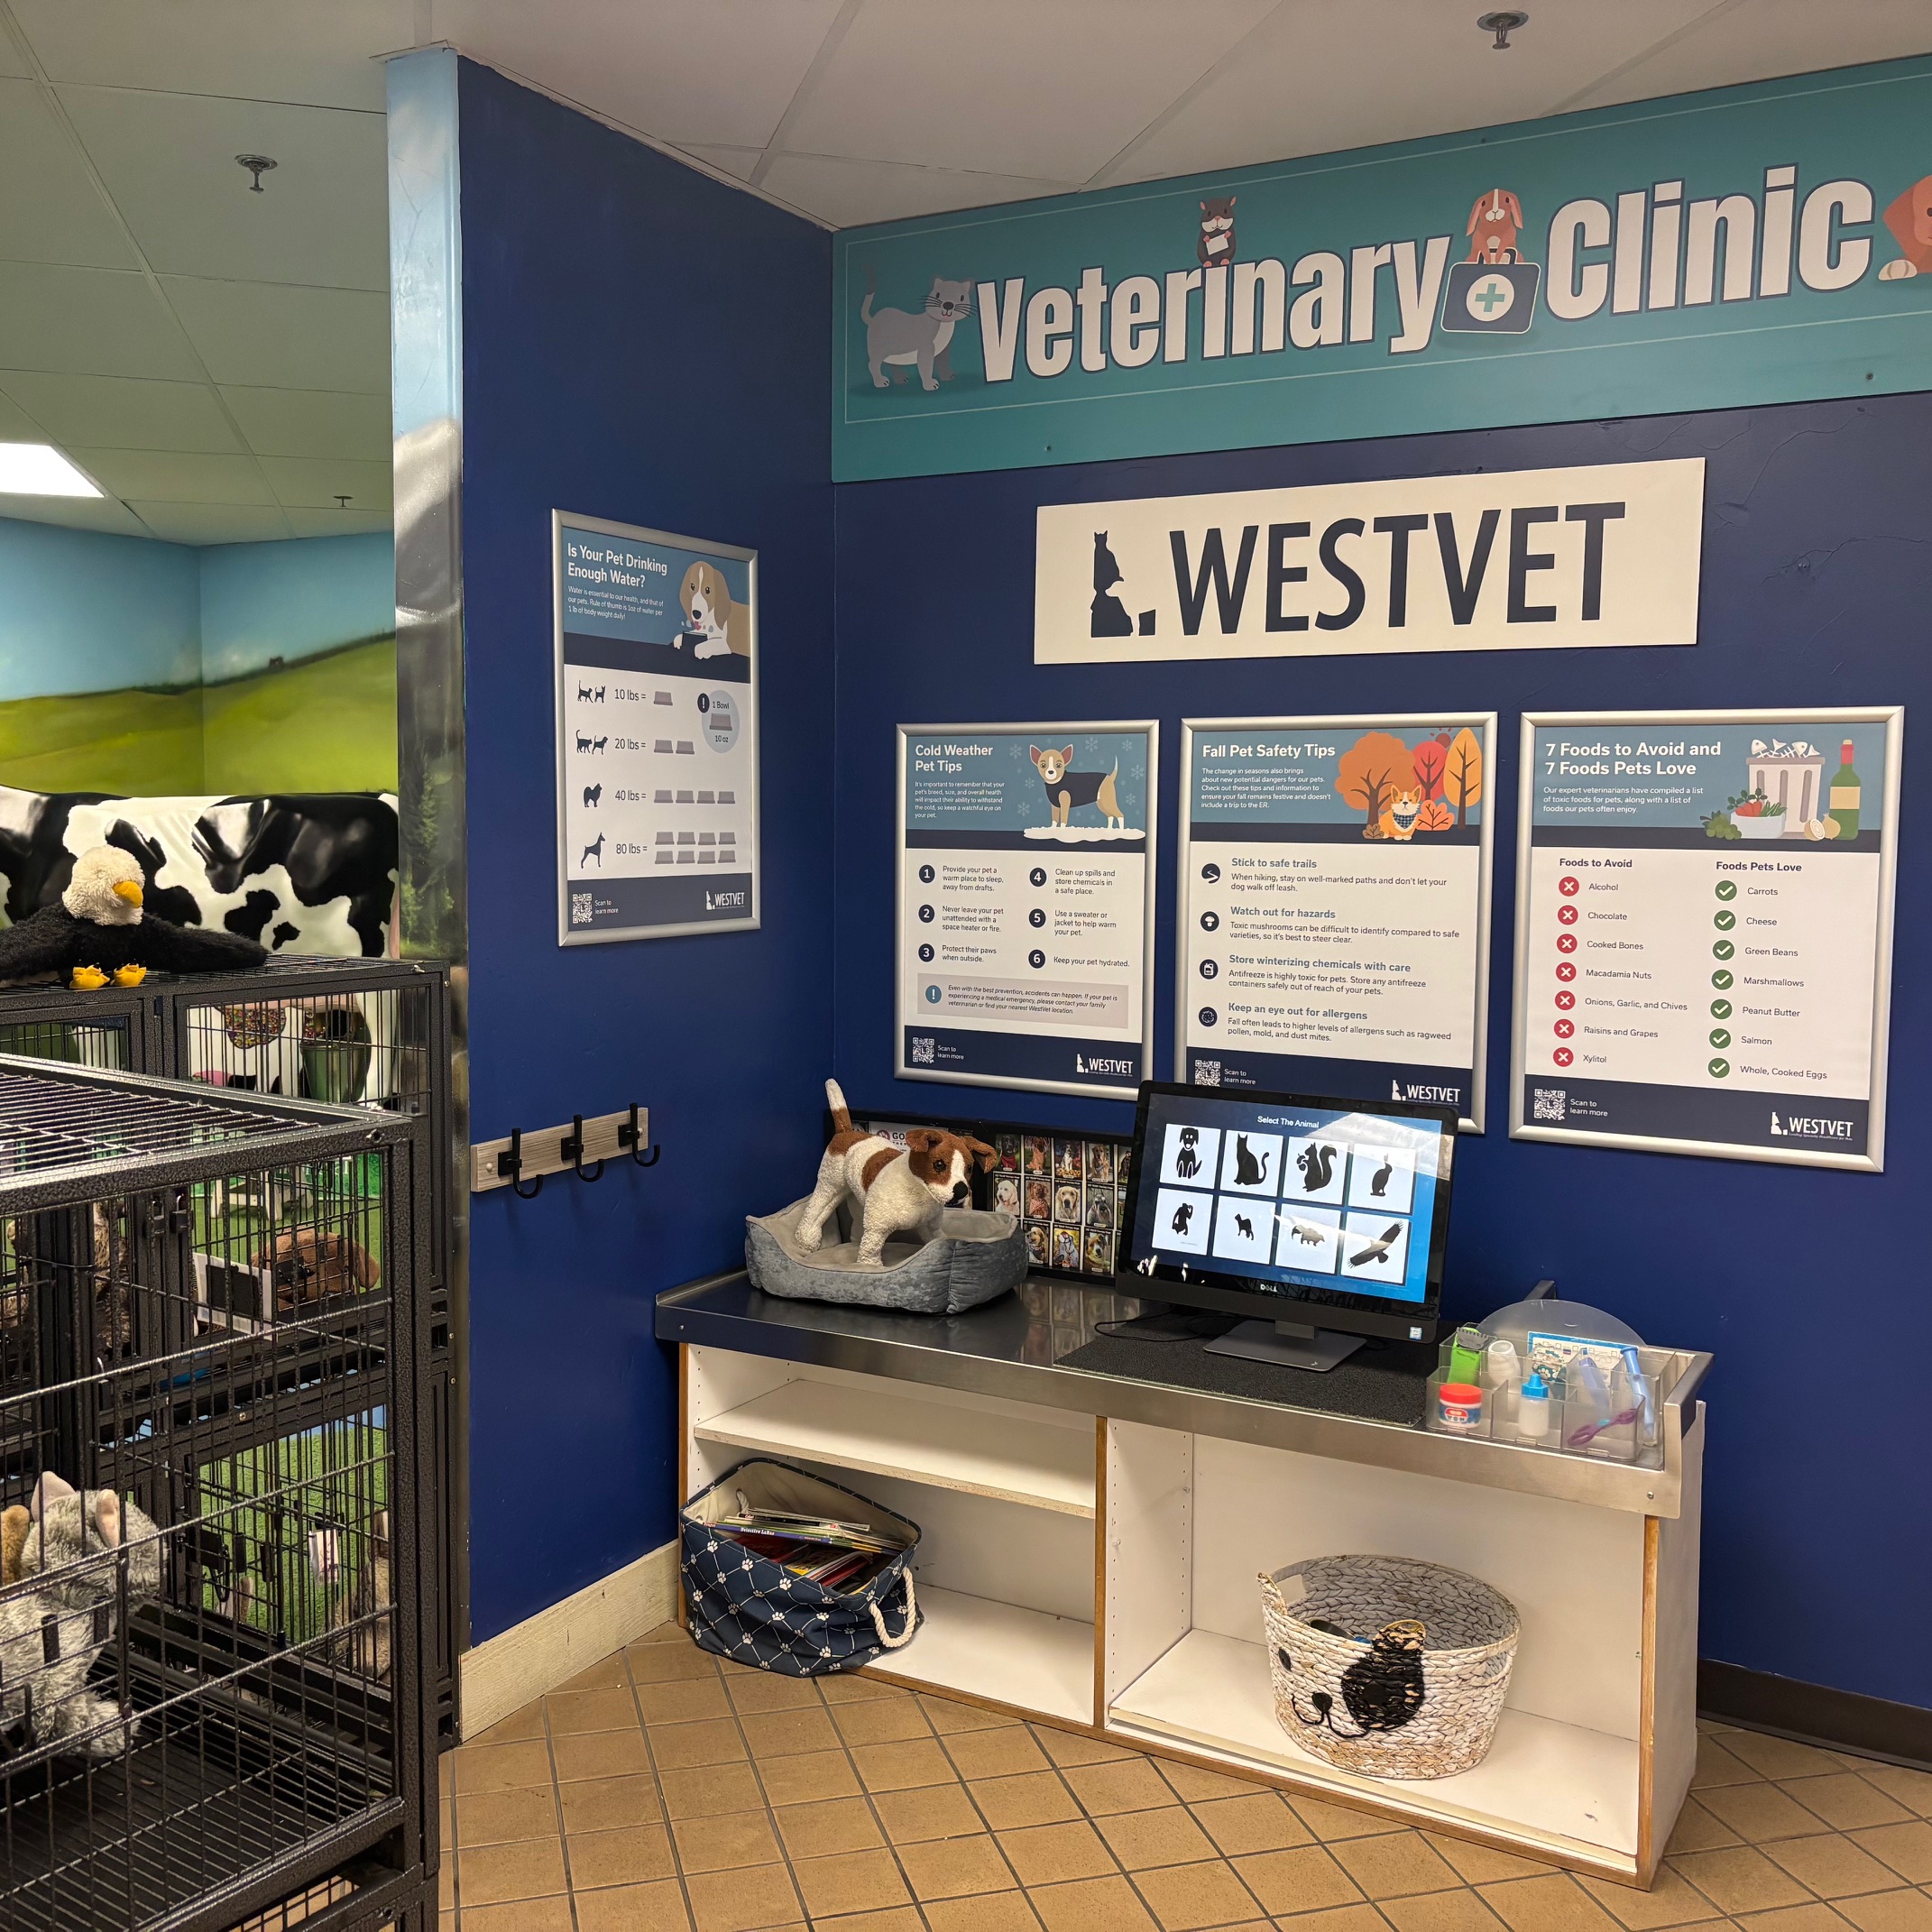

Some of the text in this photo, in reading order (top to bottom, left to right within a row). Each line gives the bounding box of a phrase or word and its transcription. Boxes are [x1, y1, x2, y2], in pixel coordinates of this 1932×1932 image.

[977, 164, 1876, 384] Veterinary Clinic
[567, 543, 667, 575] Is Your Pet Drinking
[567, 562, 646, 587] Enough Water?
[1169, 501, 1627, 639] WESTVET
[615, 689, 625, 700] 10
[626, 691, 639, 701] lbs
[614, 738, 625, 749] 20
[626, 739, 639, 750] lbs
[1545, 741, 1722, 757] 7 Foods to Avoid and
[915, 744, 993, 756] Cold Weather
[1202, 743, 1336, 759] Fall Pet Safety Tips
[915, 760, 962, 773] Pet Tips
[1545, 761, 1697, 776] 7 Foods Pets Love
[615, 789, 626, 801] 40
[626, 790, 639, 800] lbs
[616, 843, 627, 854] 80
[629, 844, 640, 854] lbs
[1231, 858, 1317, 869] Stick to safe trails
[1559, 858, 1633, 869] Foods to Avoid
[1716, 861, 1802, 872] Foods Pets Love
[924, 869, 931, 879] 1
[967, 867, 980, 875] your
[981, 867, 992, 875] pet
[1055, 869, 1073, 877] Clean
[1084, 869, 1101, 878] spills
[1101, 869, 1116, 878] and
[961, 875, 977, 884] place
[986, 876, 1004, 884] sleep,
[1034, 872, 1041, 882] 4
[1231, 873, 1253, 881] When
[1254, 874, 1278, 883] hiking,
[1280, 875, 1295, 883] stay
[1307, 875, 1354, 885] well-marked
[1355, 877, 1377, 886] paths
[1378, 877, 1394, 885] and
[1394, 878, 1416, 886] don't
[1417, 878, 1428, 886] let
[1429, 879, 1447, 888] your
[943, 884, 958, 892] away
[974, 884, 995, 892] drafts.
[1072, 879, 1105, 887] chemicals
[1230, 883, 1245, 892] dog
[1247, 883, 1264, 891] walk
[1265, 884, 1275, 892] off
[1588, 883, 1619, 891] Alcohol
[1061, 887, 1073, 895] safe
[1075, 888, 1094, 896] place.
[1747, 887, 1779, 897] Carrots
[714, 891, 745, 906] WESTVET
[923, 908, 930, 919] 2
[1230, 906, 1336, 918] Watch out for hazards
[1587, 912, 1627, 921] Chocolate
[1034, 913, 1041, 923] 5
[1745, 917, 1777, 927] Cheese
[1587, 941, 1644, 951] Cooked Bones
[923, 948, 930, 958] 3
[1744, 947, 1799, 958] Green Beans
[1033, 953, 1041, 964] 6
[1053, 956, 1130, 968] Keep your pet hydrated.
[1228, 954, 1411, 972] Store winterizing chemicals with care
[1586, 970, 1652, 980] Macadamia Nuts
[1743, 977, 1805, 989] Marshmallows
[1585, 998, 1688, 1011] Onions, Garlic, and Chives
[1228, 1003, 1367, 1020] Keep an eye out for allergens
[1742, 1007, 1801, 1017] Peanut Butter
[1584, 1026, 1659, 1039] Raisins and Grapes
[1741, 1036, 1772, 1045] Salmon
[1583, 1054, 1607, 1064] Xylitol
[1089, 1058, 1133, 1074] WESTVET
[1740, 1065, 1827, 1081] Whole, Cooked Eggs
[1406, 1084, 1460, 1102] WESTVET
[1570, 1099, 1597, 1108] Scan to
[1569, 1108, 1608, 1117] learn more
[1257, 1116, 1320, 1128] Select The Animal
[1789, 1117, 1854, 1138] WESTVET
